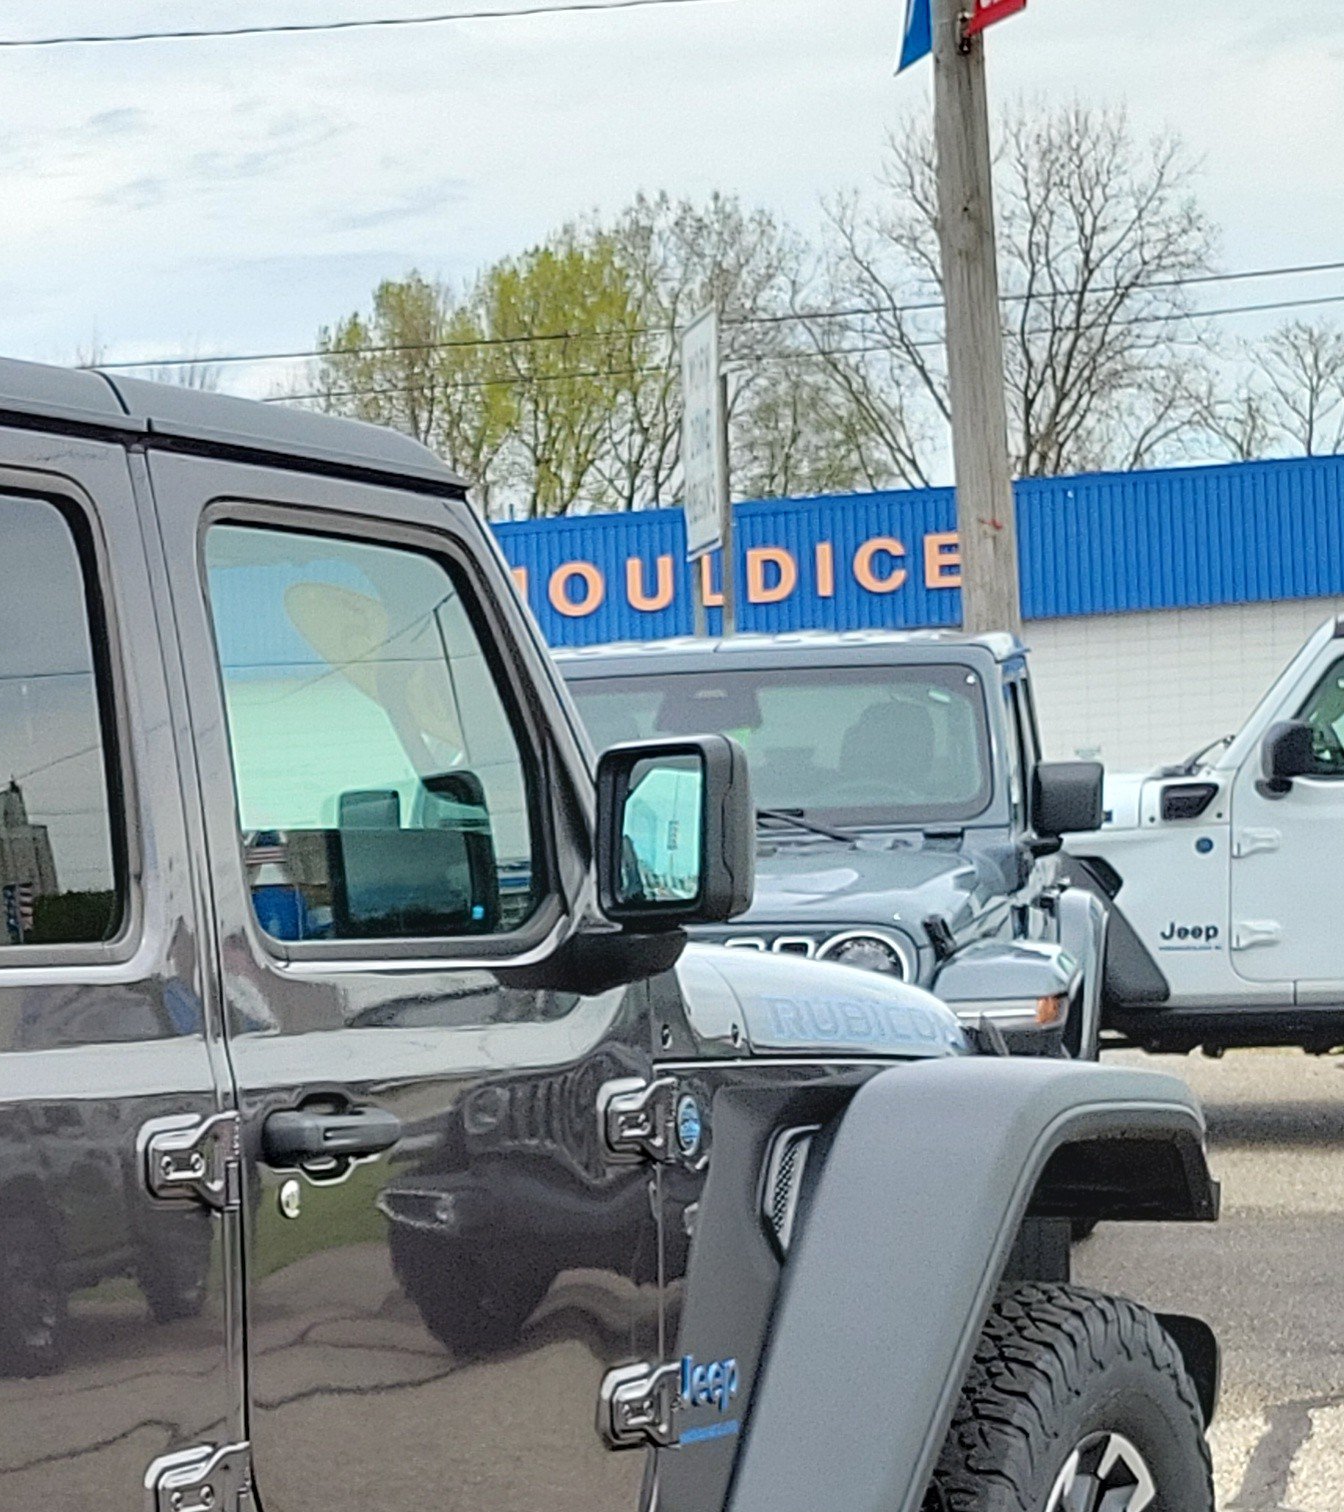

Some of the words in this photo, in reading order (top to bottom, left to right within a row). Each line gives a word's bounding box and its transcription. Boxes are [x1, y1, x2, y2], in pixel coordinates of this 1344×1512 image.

[511, 532, 962, 617] OULDICE
[1159, 921, 1219, 942] Jeep
[680, 1353, 740, 1413] Jeep
